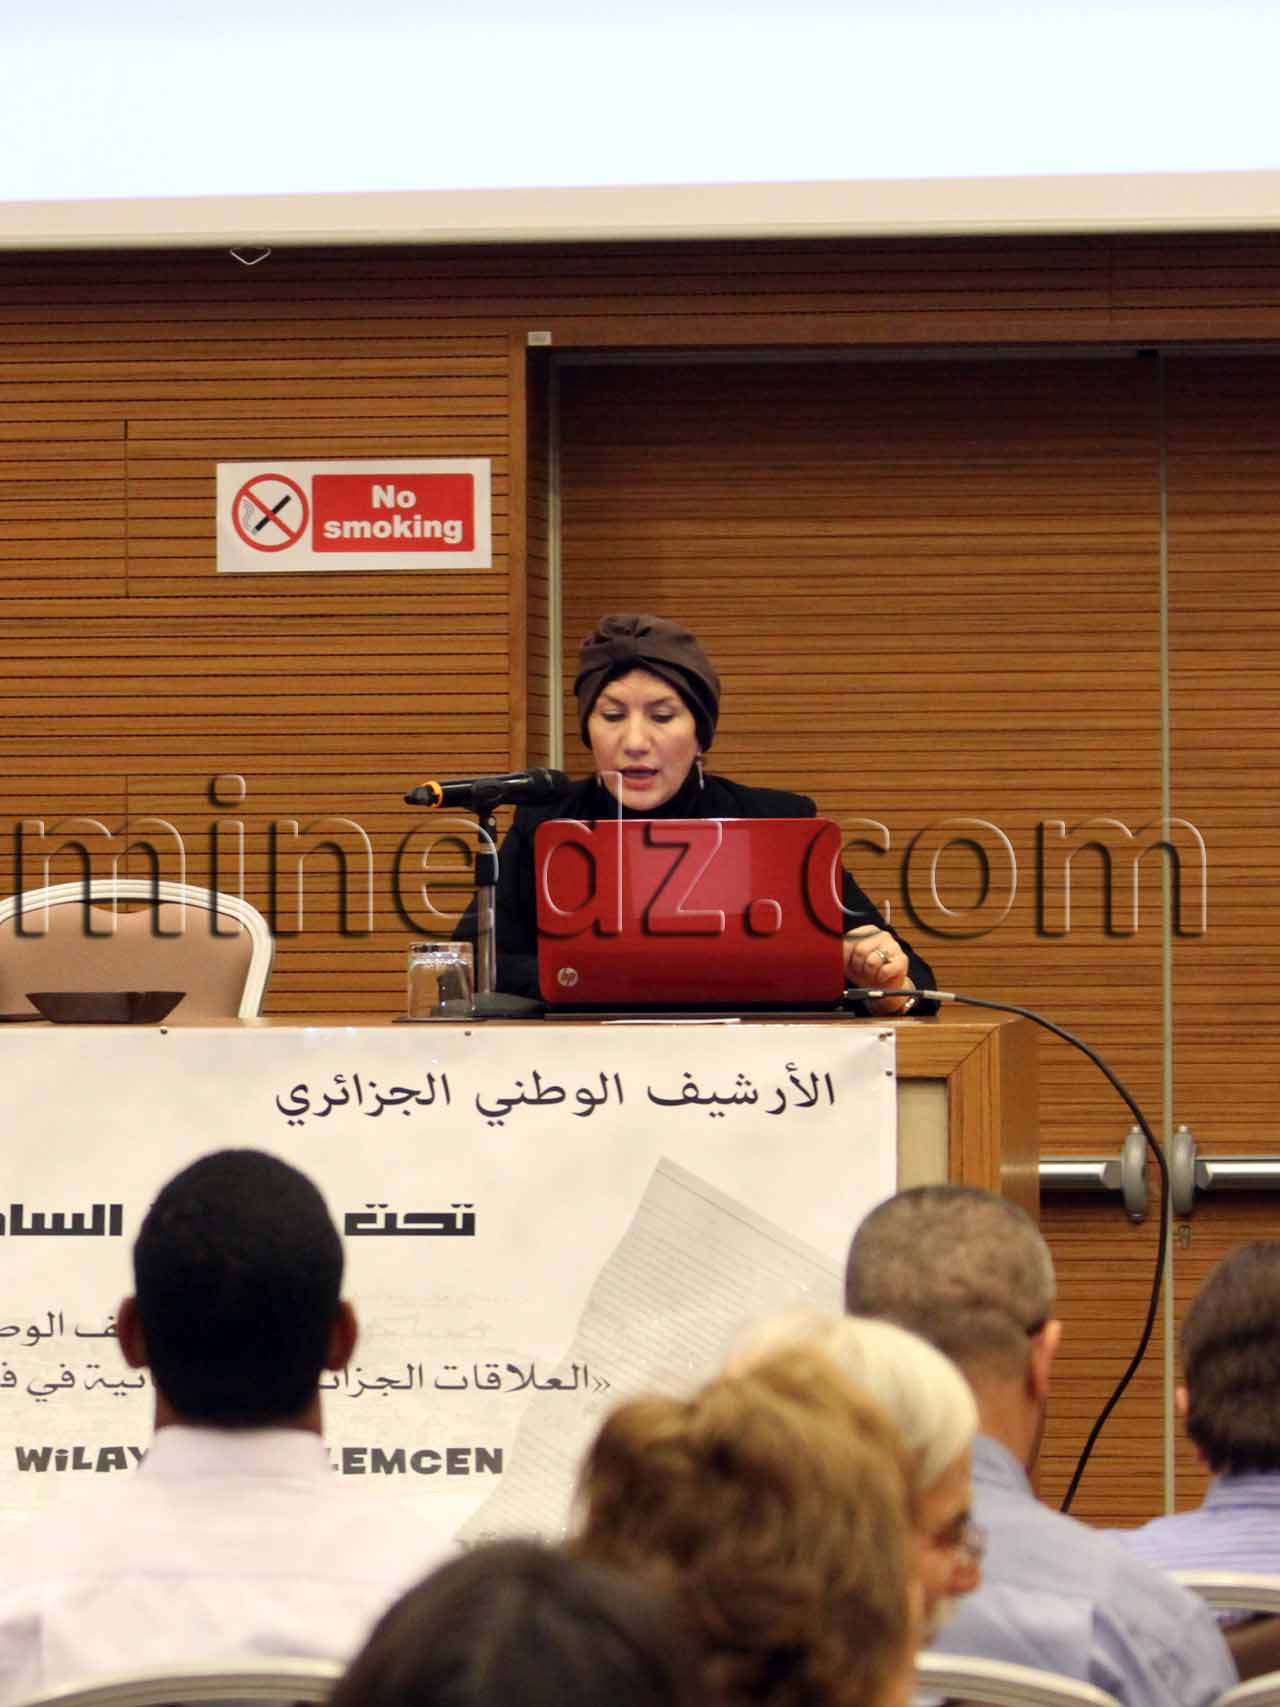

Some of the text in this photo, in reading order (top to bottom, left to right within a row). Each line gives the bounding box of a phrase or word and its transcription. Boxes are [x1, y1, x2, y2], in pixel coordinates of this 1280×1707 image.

[372, 485, 417, 509] No
[323, 514, 464, 544] smoking
[276, 1062, 836, 1127] الأرشيف الوطني الجزائري
[344, 1204, 476, 1238] تحت
[24, 1360, 76, 1402] في
